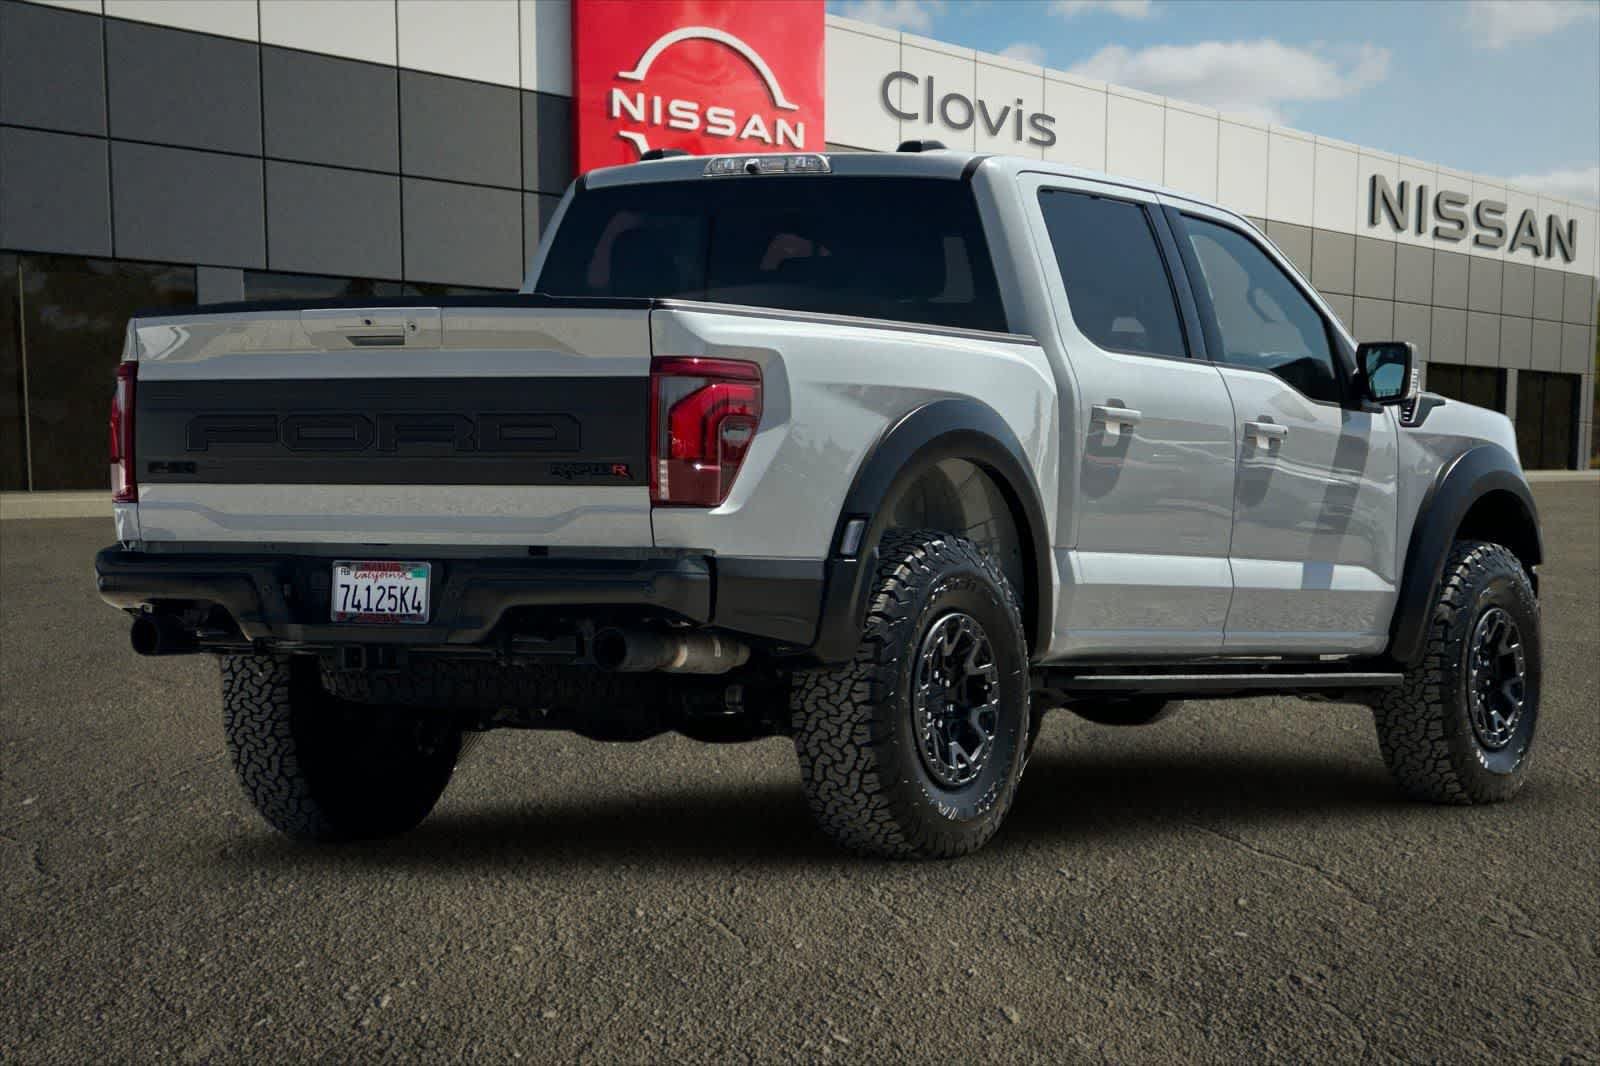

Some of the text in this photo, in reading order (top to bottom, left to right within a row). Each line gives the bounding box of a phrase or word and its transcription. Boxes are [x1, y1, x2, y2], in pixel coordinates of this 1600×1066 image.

[610, 88, 805, 148] NISSAN
[882, 71, 1057, 147] Clovis
[1368, 174, 1577, 263] NISSAN
[186, 412, 581, 452] FORD
[340, 584, 422, 613] 74125K4
[353, 570, 412, 583] California
